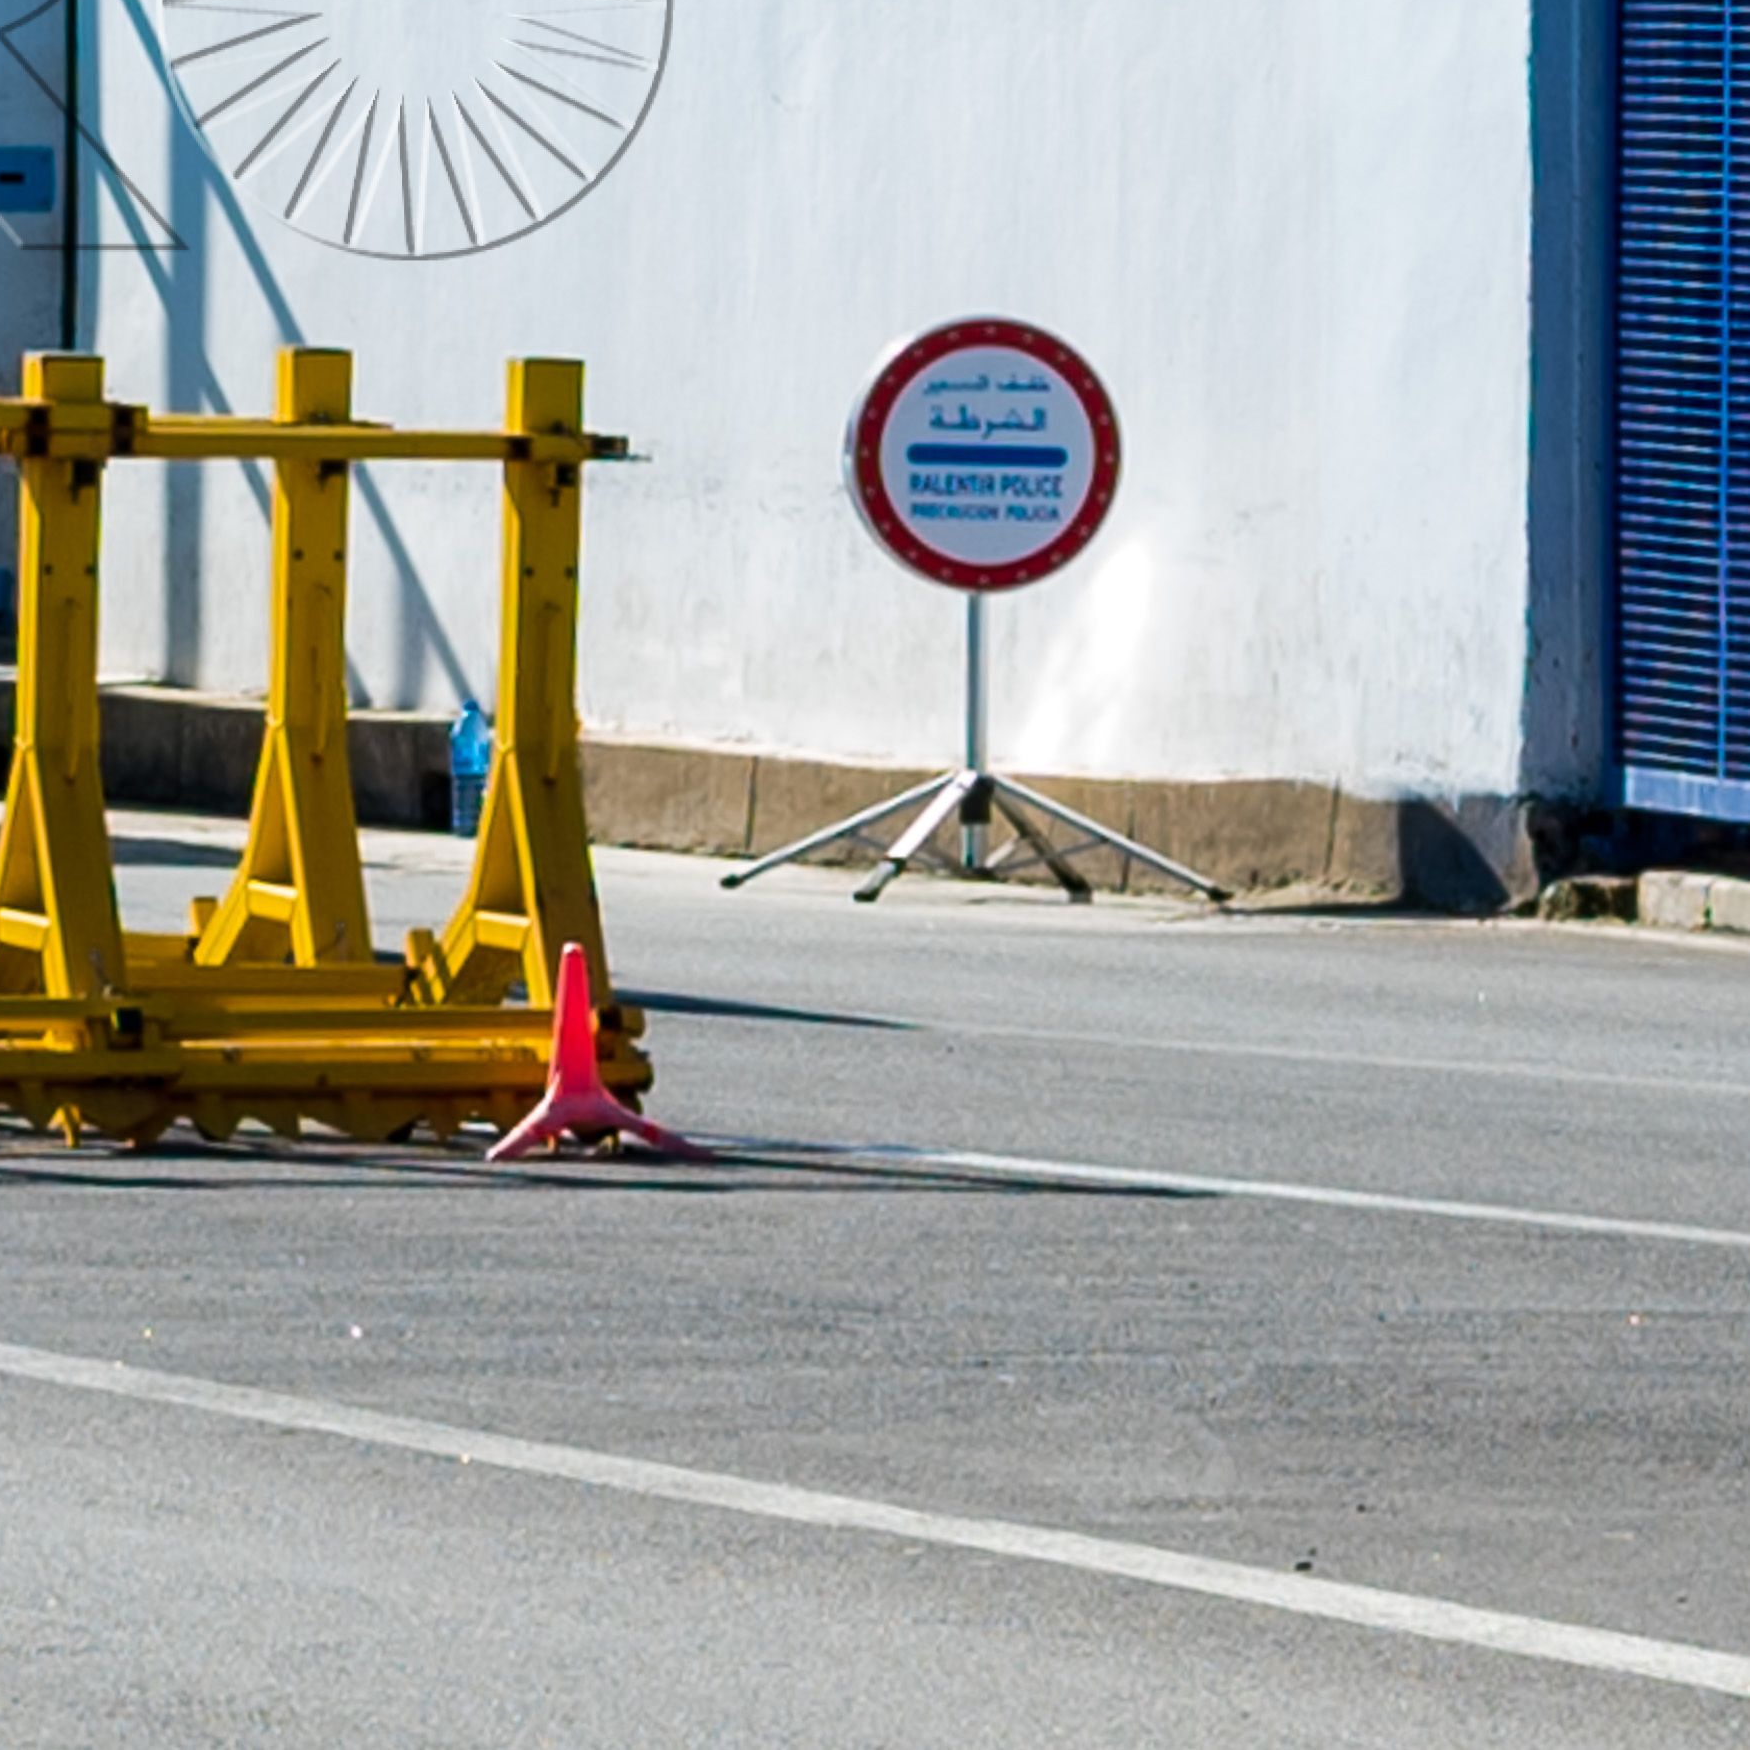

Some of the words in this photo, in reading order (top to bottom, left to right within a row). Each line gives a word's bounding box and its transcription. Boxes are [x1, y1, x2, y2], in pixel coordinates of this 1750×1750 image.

[930, 404, 1046, 440] الشرطة
[910, 473, 996, 496] RALENTIR
[1001, 474, 1064, 498] POLICE
